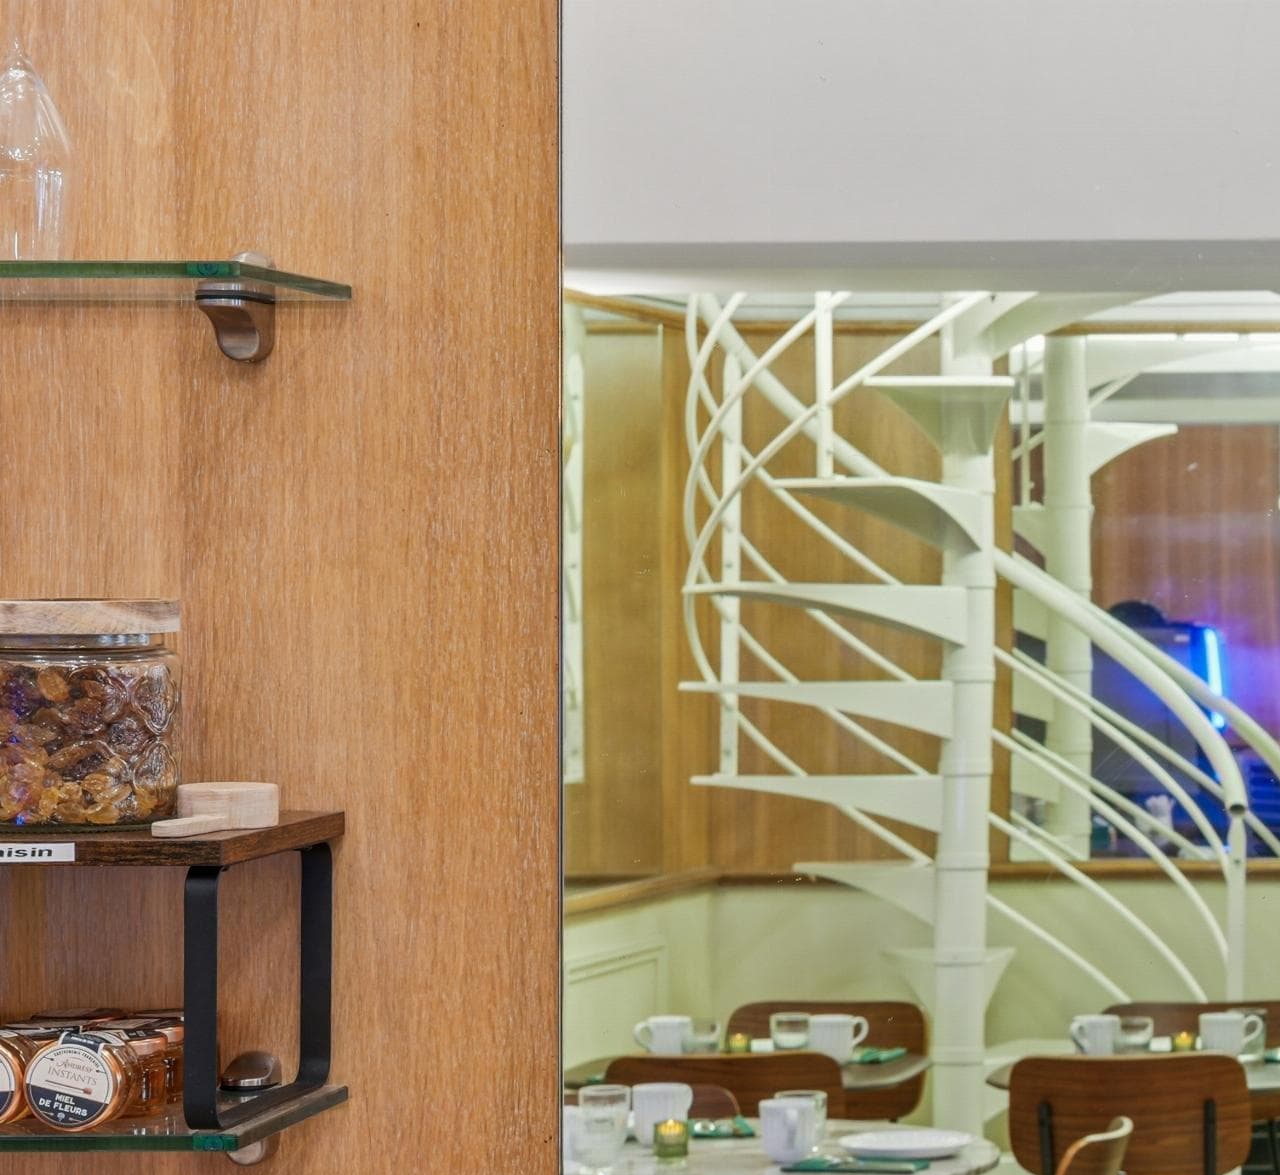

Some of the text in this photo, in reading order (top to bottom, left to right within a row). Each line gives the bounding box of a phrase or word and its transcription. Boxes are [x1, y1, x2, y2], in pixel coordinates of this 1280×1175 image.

[48, 1067, 97, 1086] INSTANTS
[39, 1098, 88, 1116] DE FLEURS
[55, 1094, 75, 1105] MIEL
